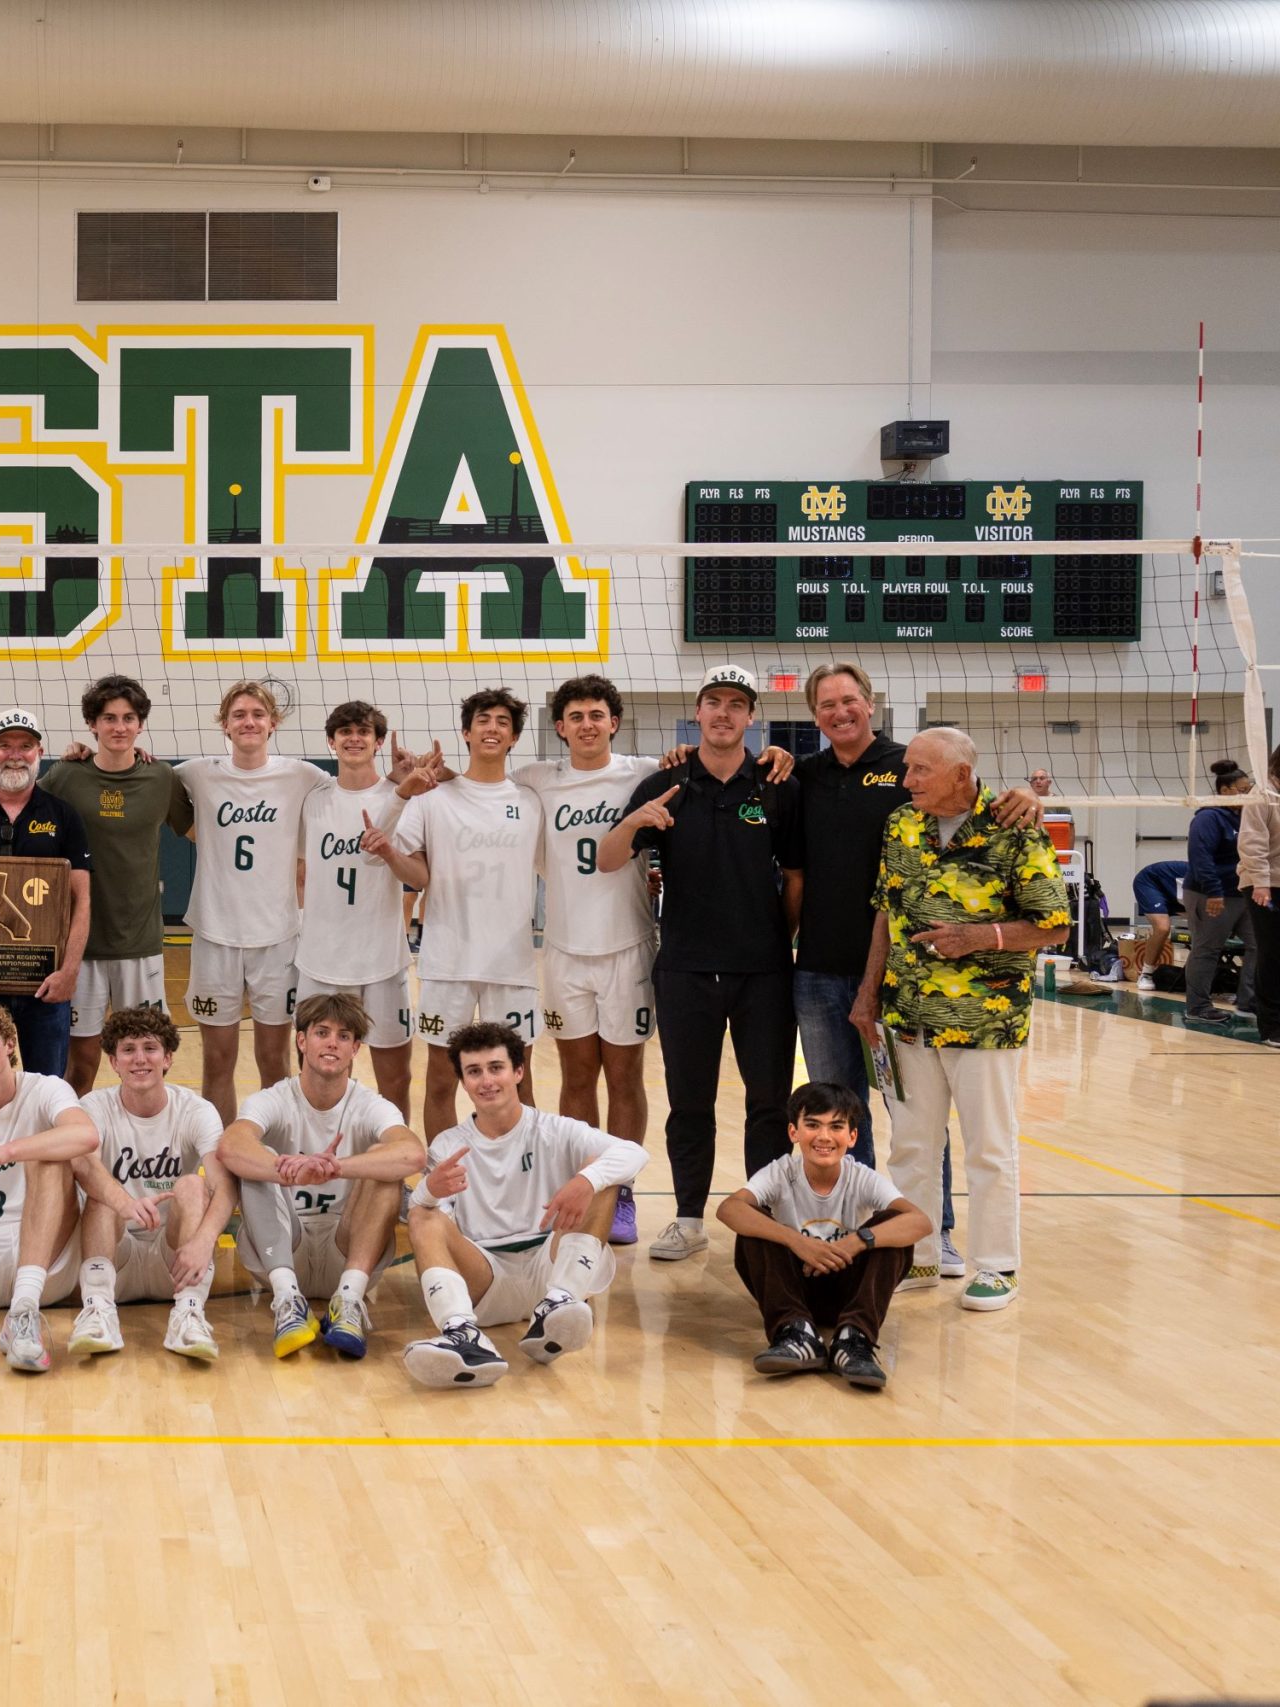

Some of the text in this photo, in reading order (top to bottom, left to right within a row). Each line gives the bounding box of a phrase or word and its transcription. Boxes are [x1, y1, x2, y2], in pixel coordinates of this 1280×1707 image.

[700, 488, 770, 499] PLYR FLS PTS
[1060, 488, 1130, 499] PLYR FLS PTS
[788, 526, 866, 541] MUSTANGS
[898, 535, 934, 543] PERIOD
[975, 526, 1033, 541] VISITOR
[796, 583, 829, 594] FOULS
[842, 583, 870, 594] T.O.L.
[882, 583, 950, 594] PLAYER FOUL
[962, 583, 990, 594] T.O.L.
[1001, 583, 1034, 594] FOULS
[796, 626, 829, 638] SCORE
[897, 626, 933, 638] MATCH
[1000, 626, 1034, 638] SCORE
[863, 771, 898, 786] Costa
[217, 800, 277, 827] Costa
[506, 805, 520, 820] 21
[555, 801, 620, 831] Costa
[28, 820, 56, 833] Costa
[321, 830, 365, 860] Cost
[455, 825, 519, 853] Costa
[235, 835, 255, 871] 6
[577, 838, 597, 875] 9
[337, 867, 356, 905] 4
[466, 860, 506, 900] 21
[22, 877, 50, 906] CIF
[399, 1009, 410, 1037] 4
[506, 1010, 535, 1038] 21
[635, 1007, 650, 1035] 9
[112, 1146, 183, 1185] Costa
